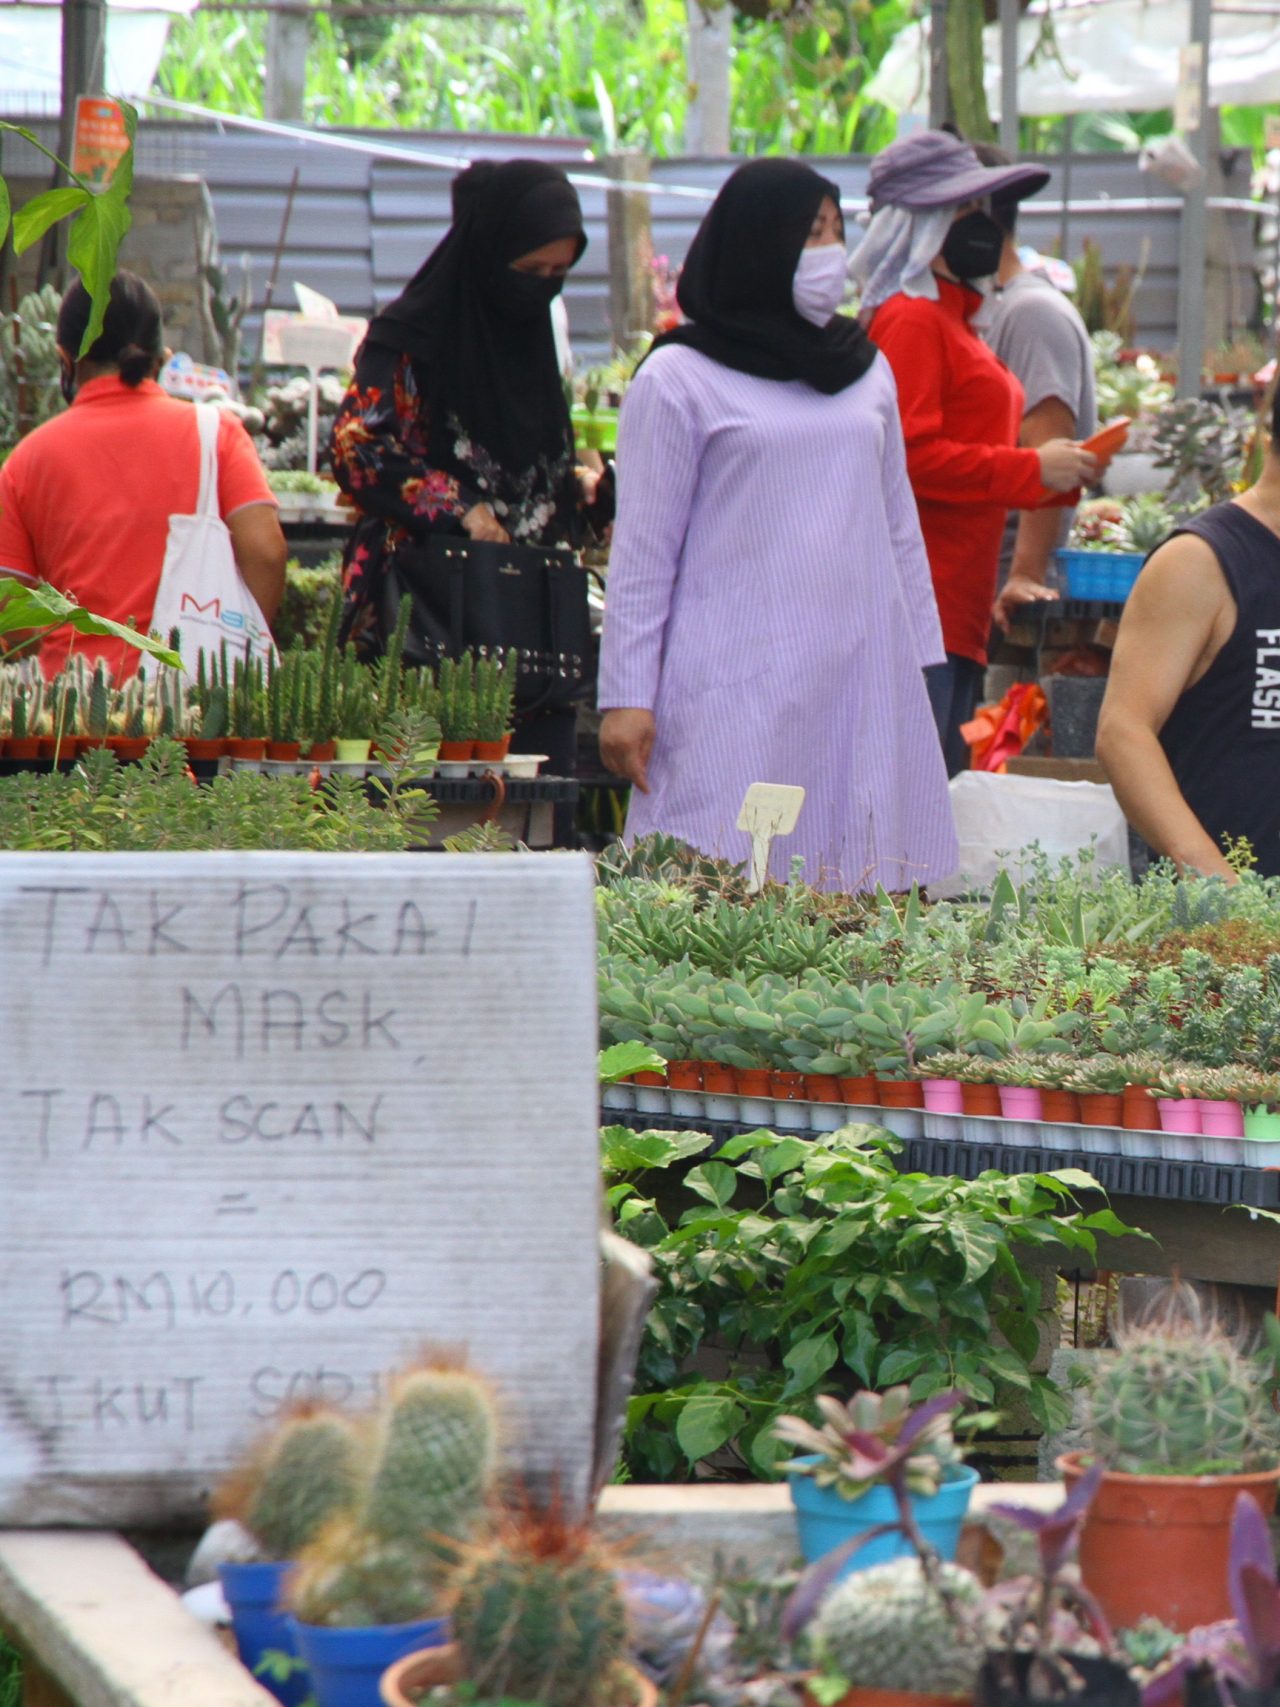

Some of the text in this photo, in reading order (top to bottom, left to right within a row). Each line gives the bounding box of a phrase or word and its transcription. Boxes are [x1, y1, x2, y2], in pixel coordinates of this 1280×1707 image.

[18, 881, 479, 968] TAK PAKAI
[20, 1088, 385, 1159] TAK SCAN
